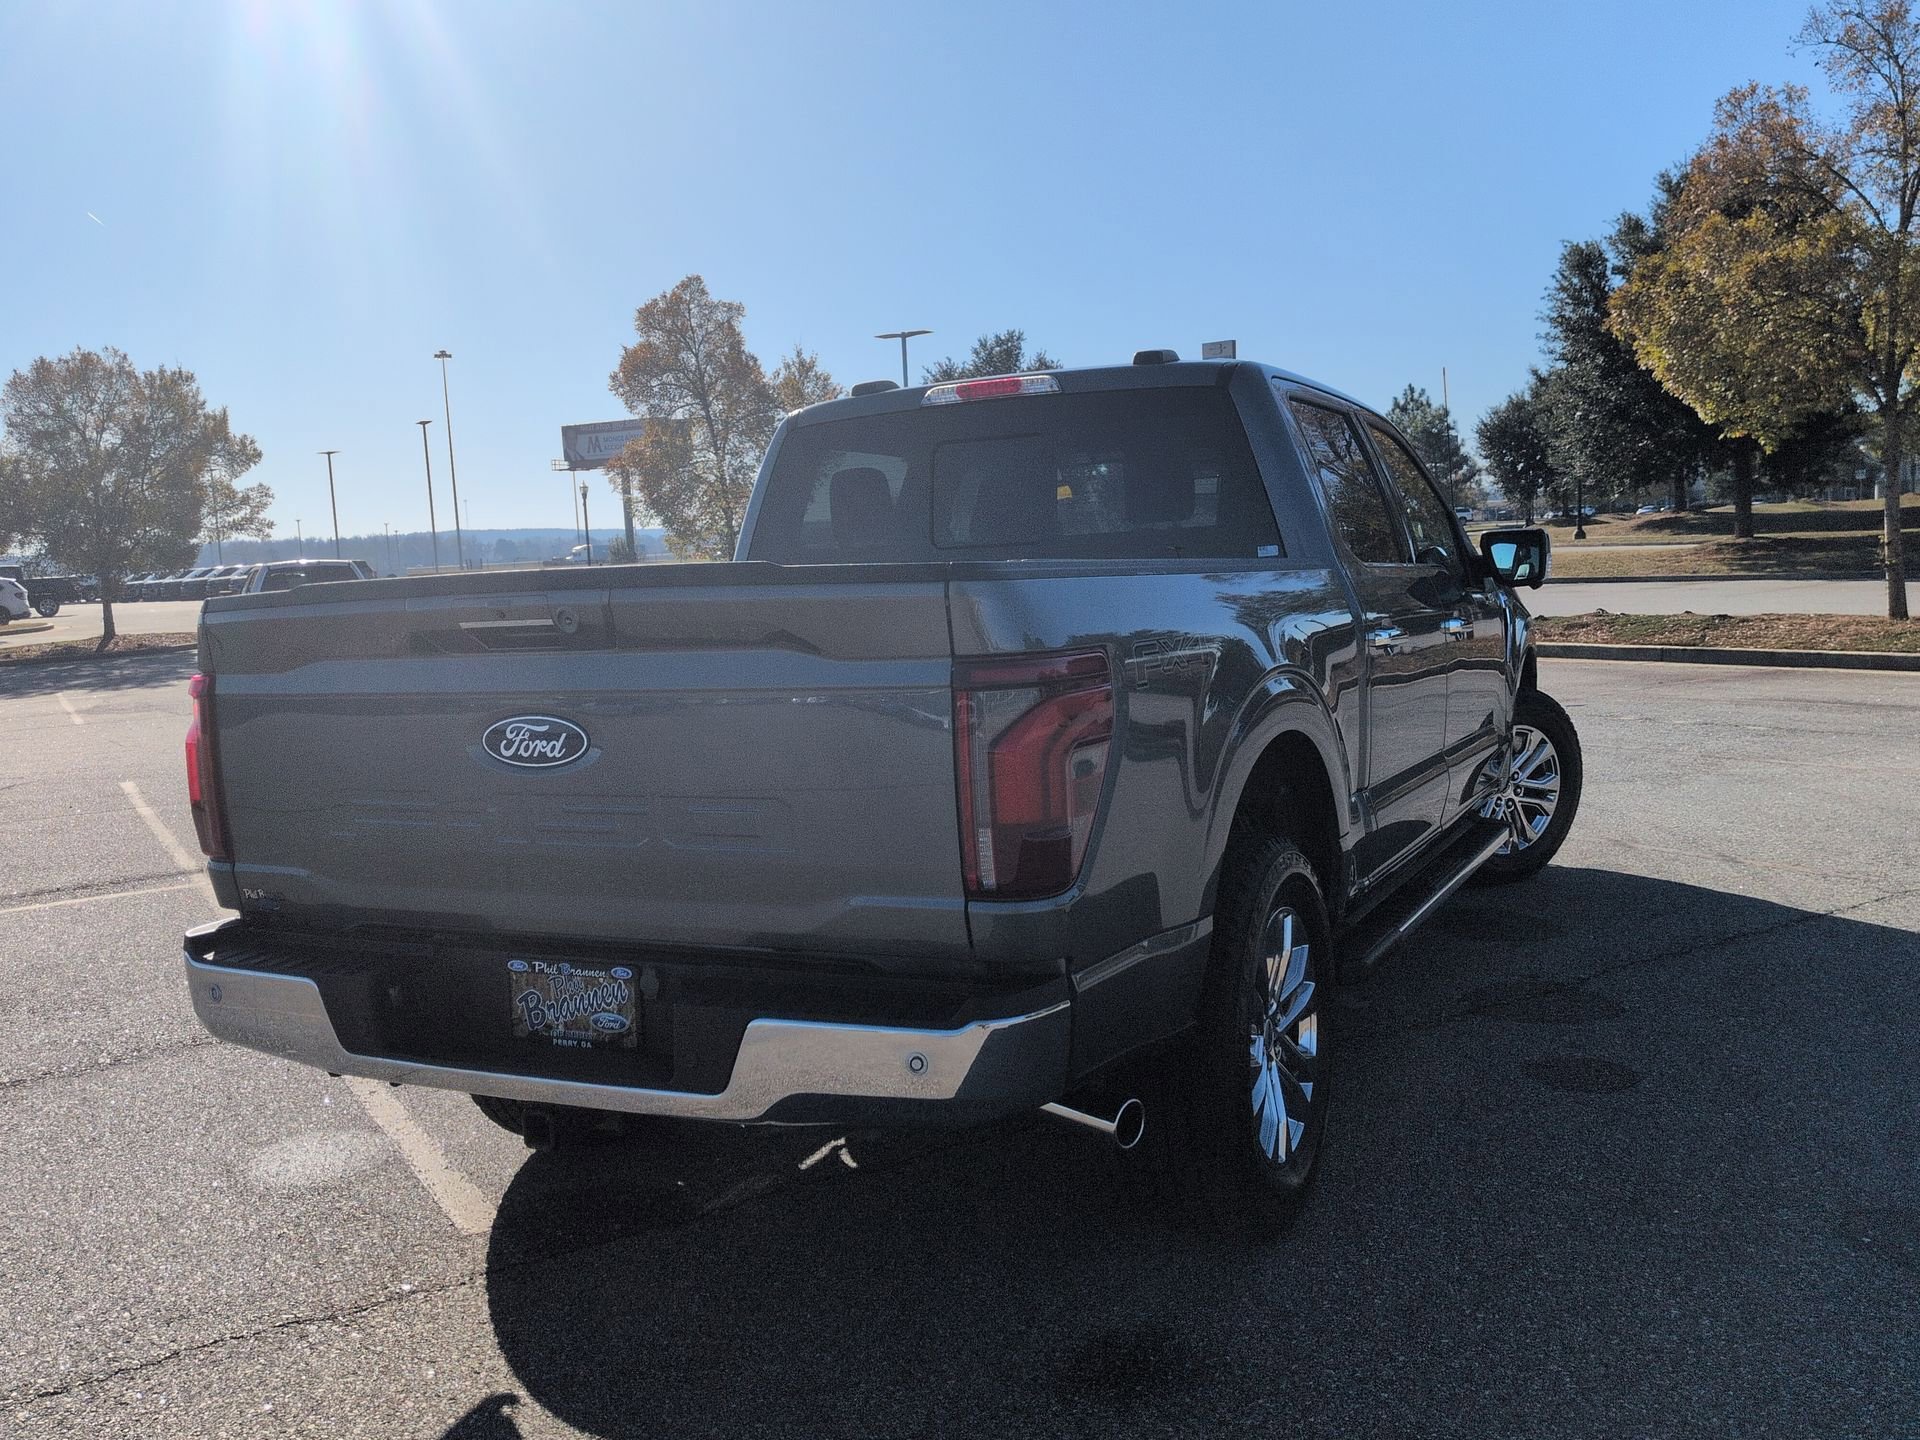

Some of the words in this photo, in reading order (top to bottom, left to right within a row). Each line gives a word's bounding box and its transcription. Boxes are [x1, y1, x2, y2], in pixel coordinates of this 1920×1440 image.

[500, 723, 566, 758] Ford
[532, 961, 558, 975] Phil
[558, 962, 606, 978] Brannen
[516, 980, 629, 1031] Brannen
[597, 1016, 621, 1030] Ford
